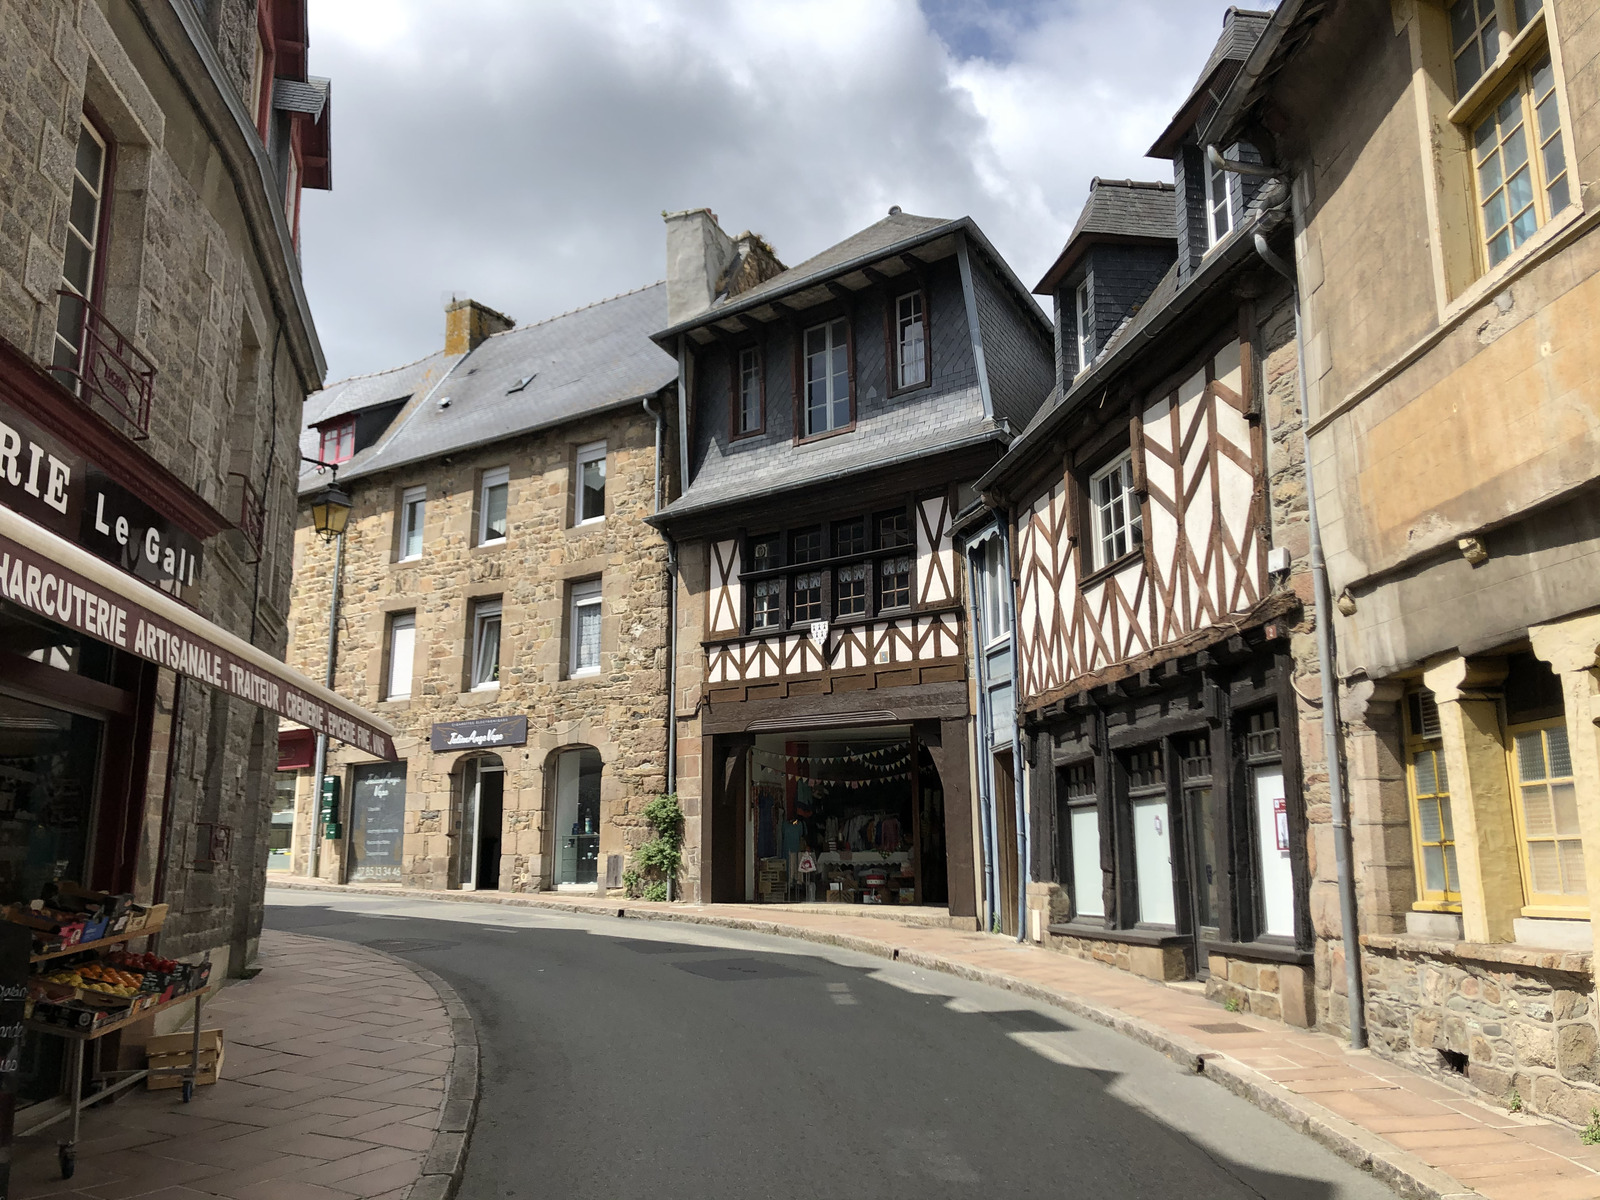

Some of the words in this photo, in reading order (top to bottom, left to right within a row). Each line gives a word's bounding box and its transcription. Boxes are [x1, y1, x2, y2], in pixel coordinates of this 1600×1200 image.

[0, 421, 71, 515] RIE
[95, 492, 129, 546] Le
[145, 527, 195, 587] Gall
[135, 619, 222, 688] ARTISANALE
[229, 663, 279, 712] TRAITEUR
[357, 725, 370, 750] FINE
